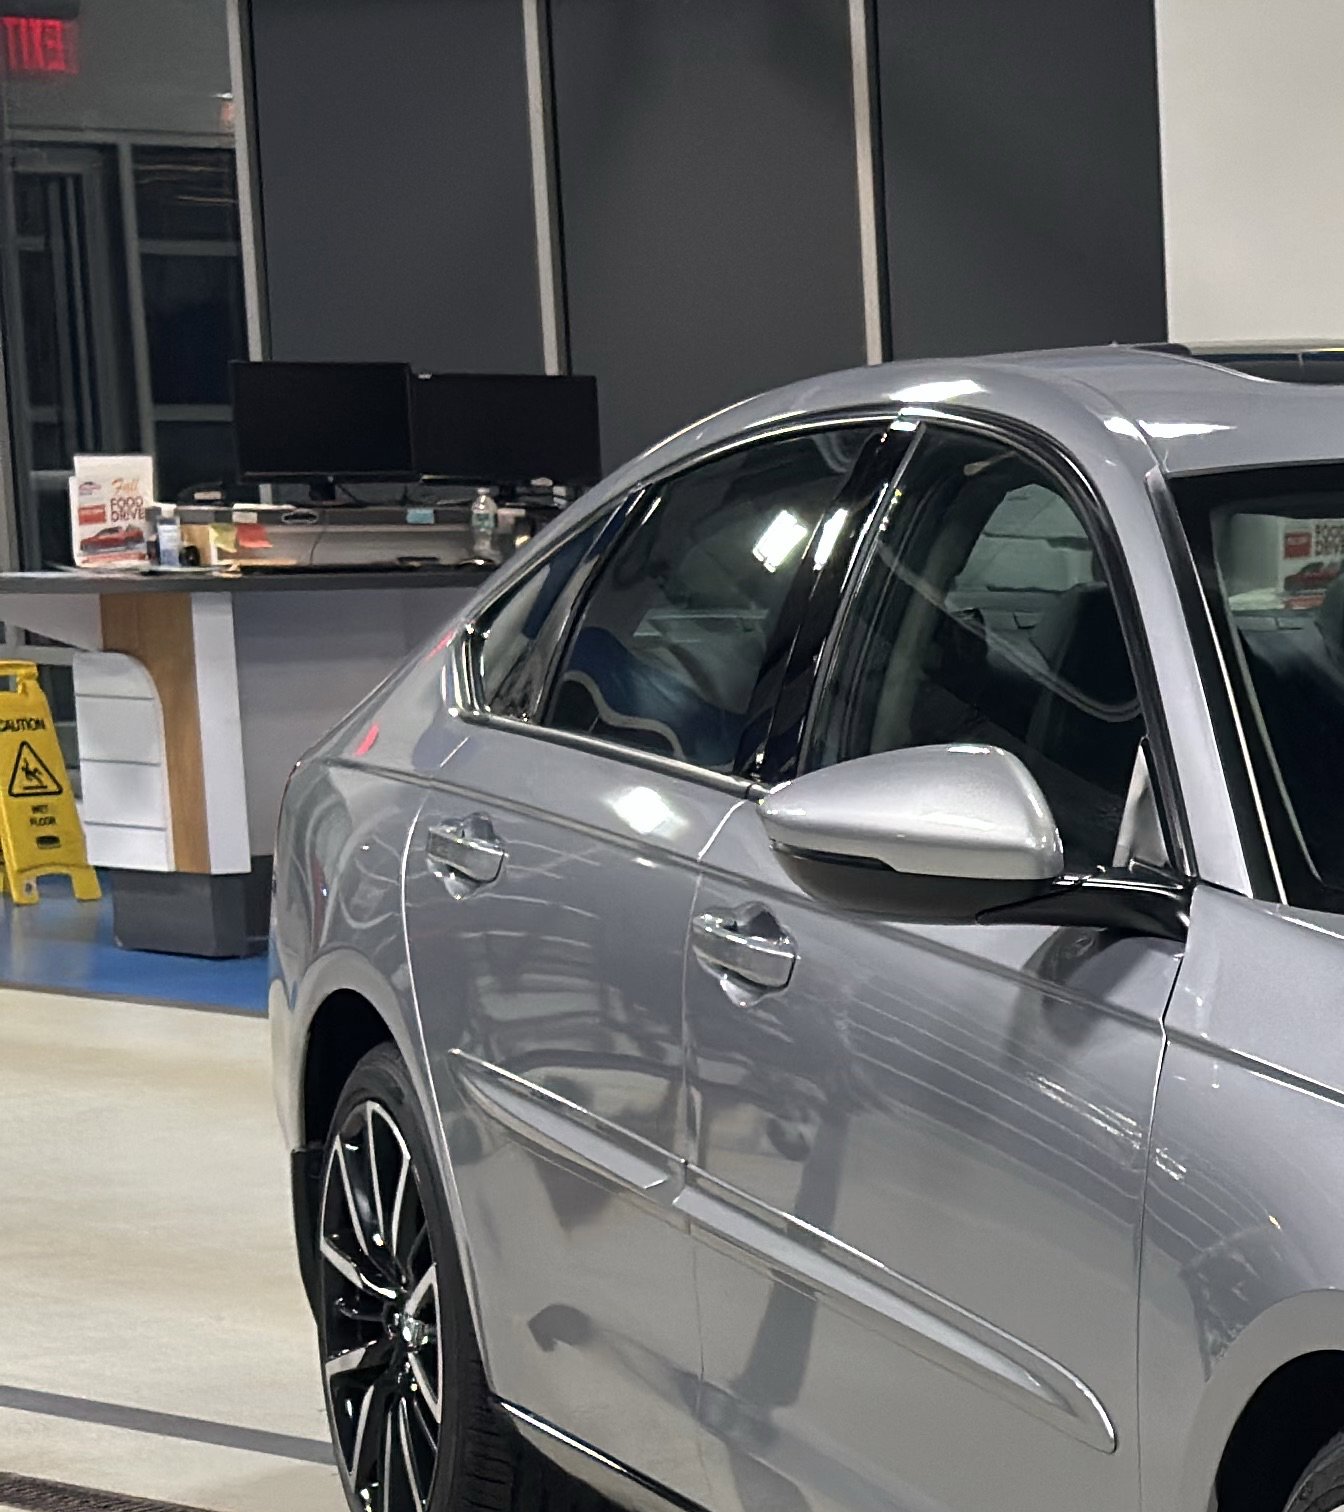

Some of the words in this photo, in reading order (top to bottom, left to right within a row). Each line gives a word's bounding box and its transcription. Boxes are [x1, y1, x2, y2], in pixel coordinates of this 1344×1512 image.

[110, 497, 144, 511] FOOD
[110, 508, 145, 522] DRIVE
[0, 718, 46, 732] CAUTION
[29, 816, 57, 827] FLOOR
